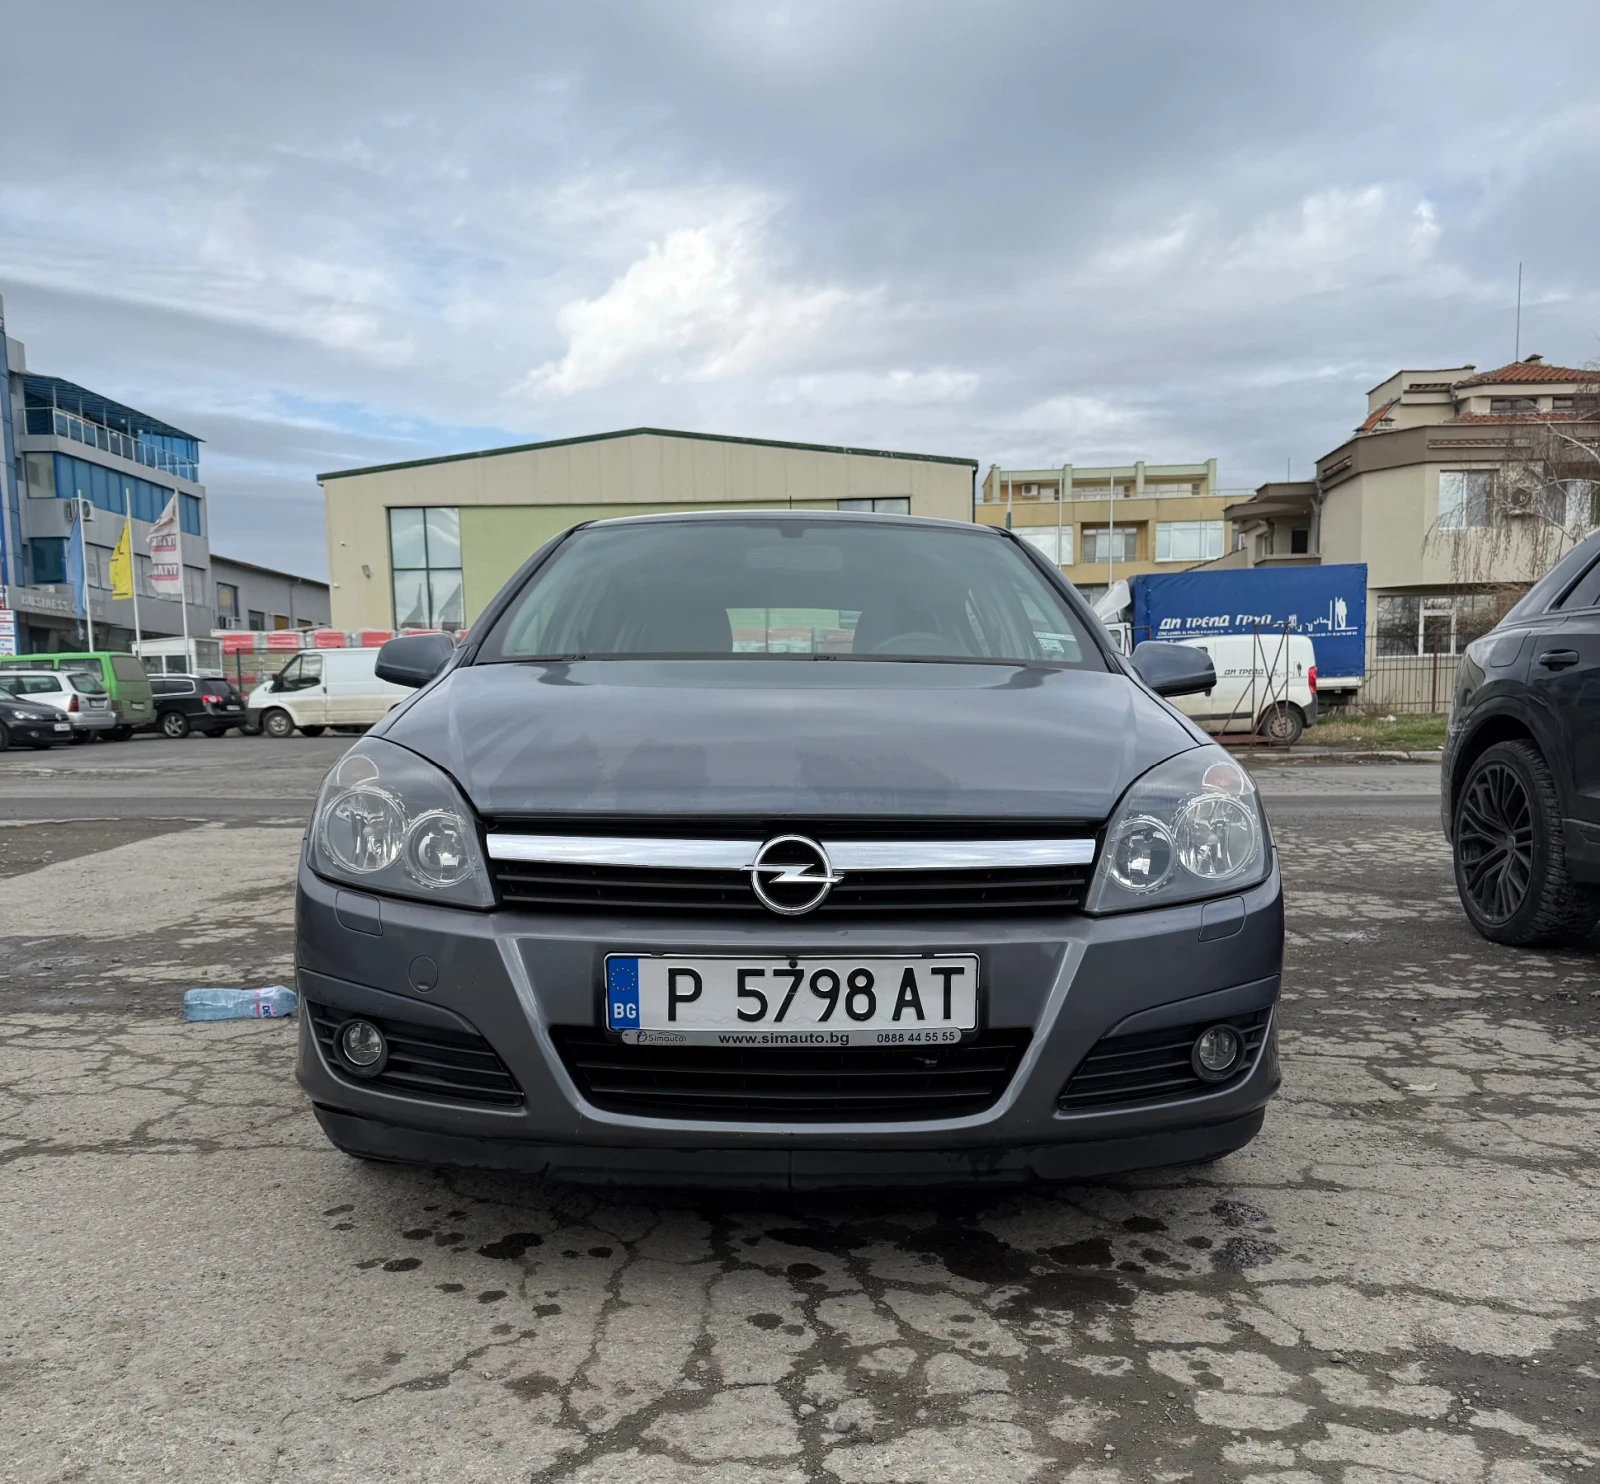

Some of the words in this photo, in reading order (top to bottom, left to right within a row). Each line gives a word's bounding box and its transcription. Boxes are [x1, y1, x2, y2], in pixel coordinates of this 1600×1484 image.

[668, 967, 702, 1021] P
[737, 967, 876, 1022] 5798
[892, 967, 965, 1021] AT
[614, 1003, 637, 1018] BG
[718, 1033, 850, 1045] www.simauto.bg
[877, 1033, 904, 1043] 0888
[907, 1033, 922, 1042] 44
[925, 1033, 939, 1042] 55
[941, 1032, 955, 1042] 55
